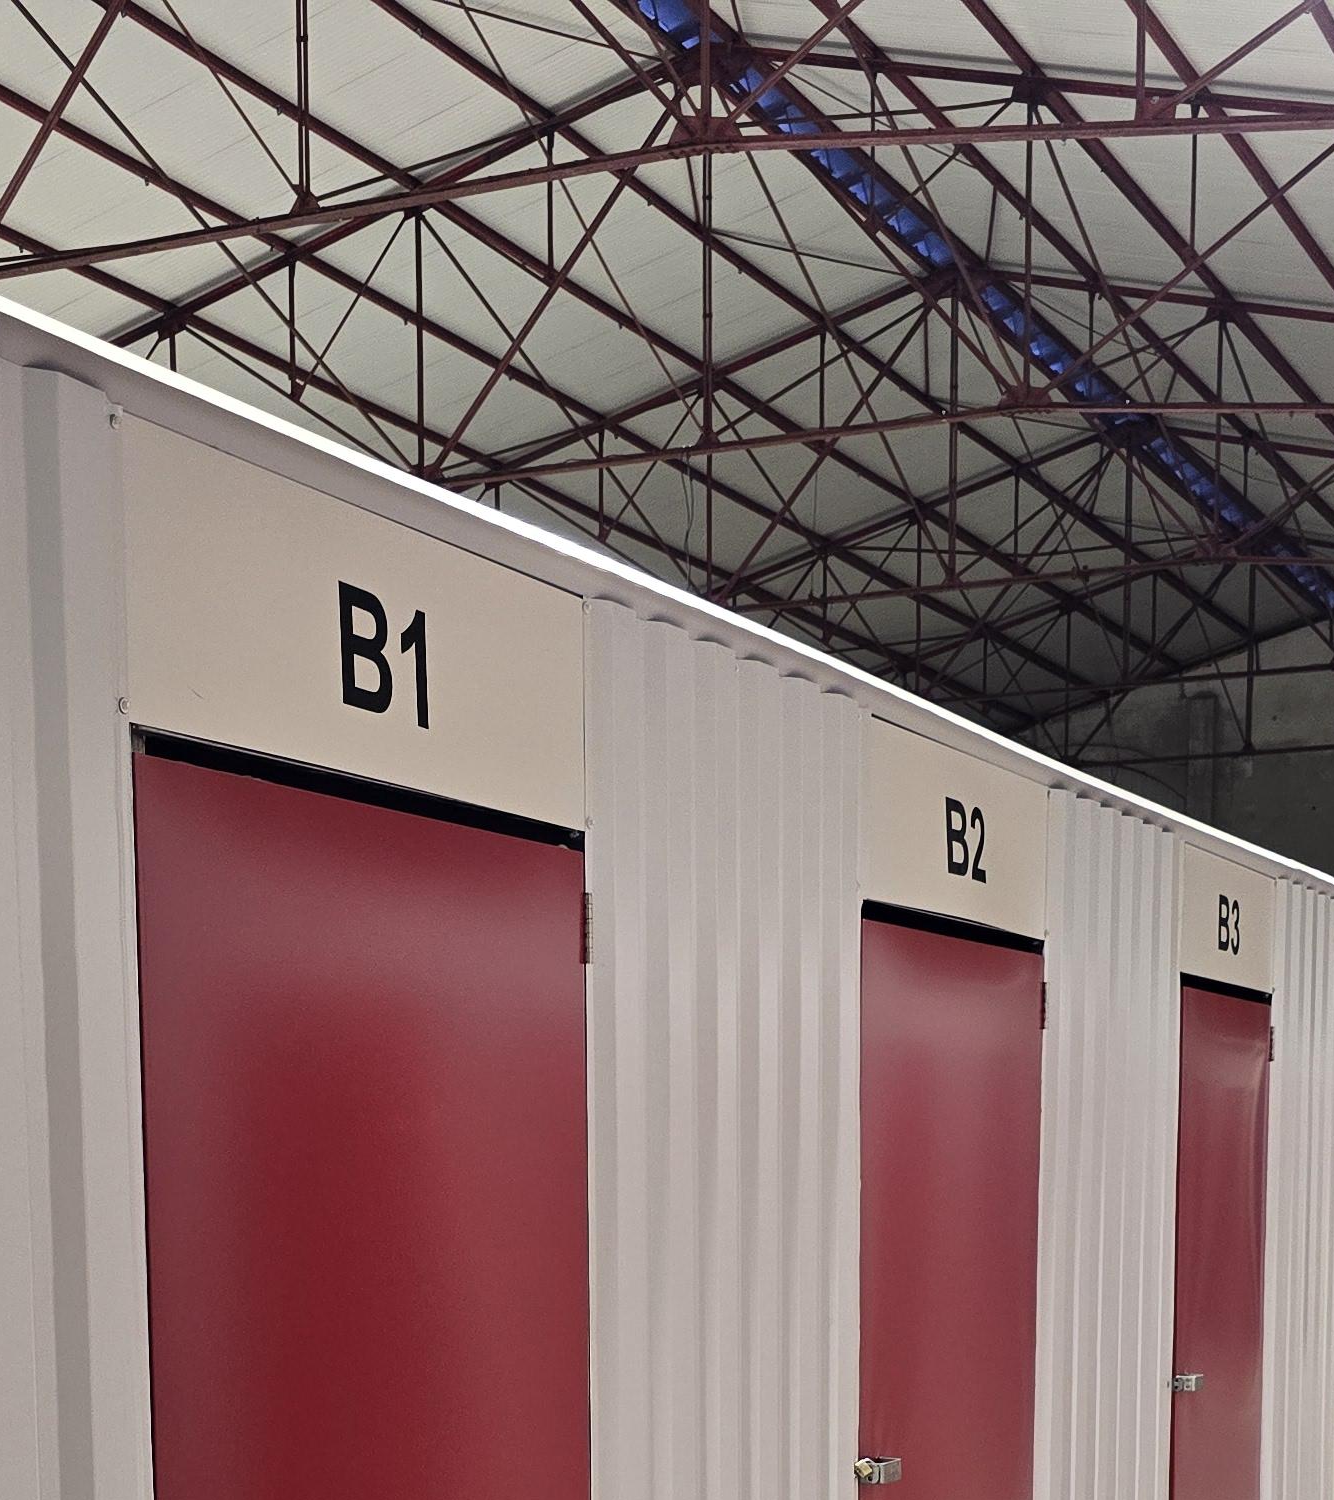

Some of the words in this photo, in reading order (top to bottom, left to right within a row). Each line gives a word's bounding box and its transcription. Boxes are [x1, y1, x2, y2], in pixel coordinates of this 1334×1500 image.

[338, 579, 430, 730] B1
[945, 796, 987, 884] B2
[1218, 893, 1240, 956] B3
